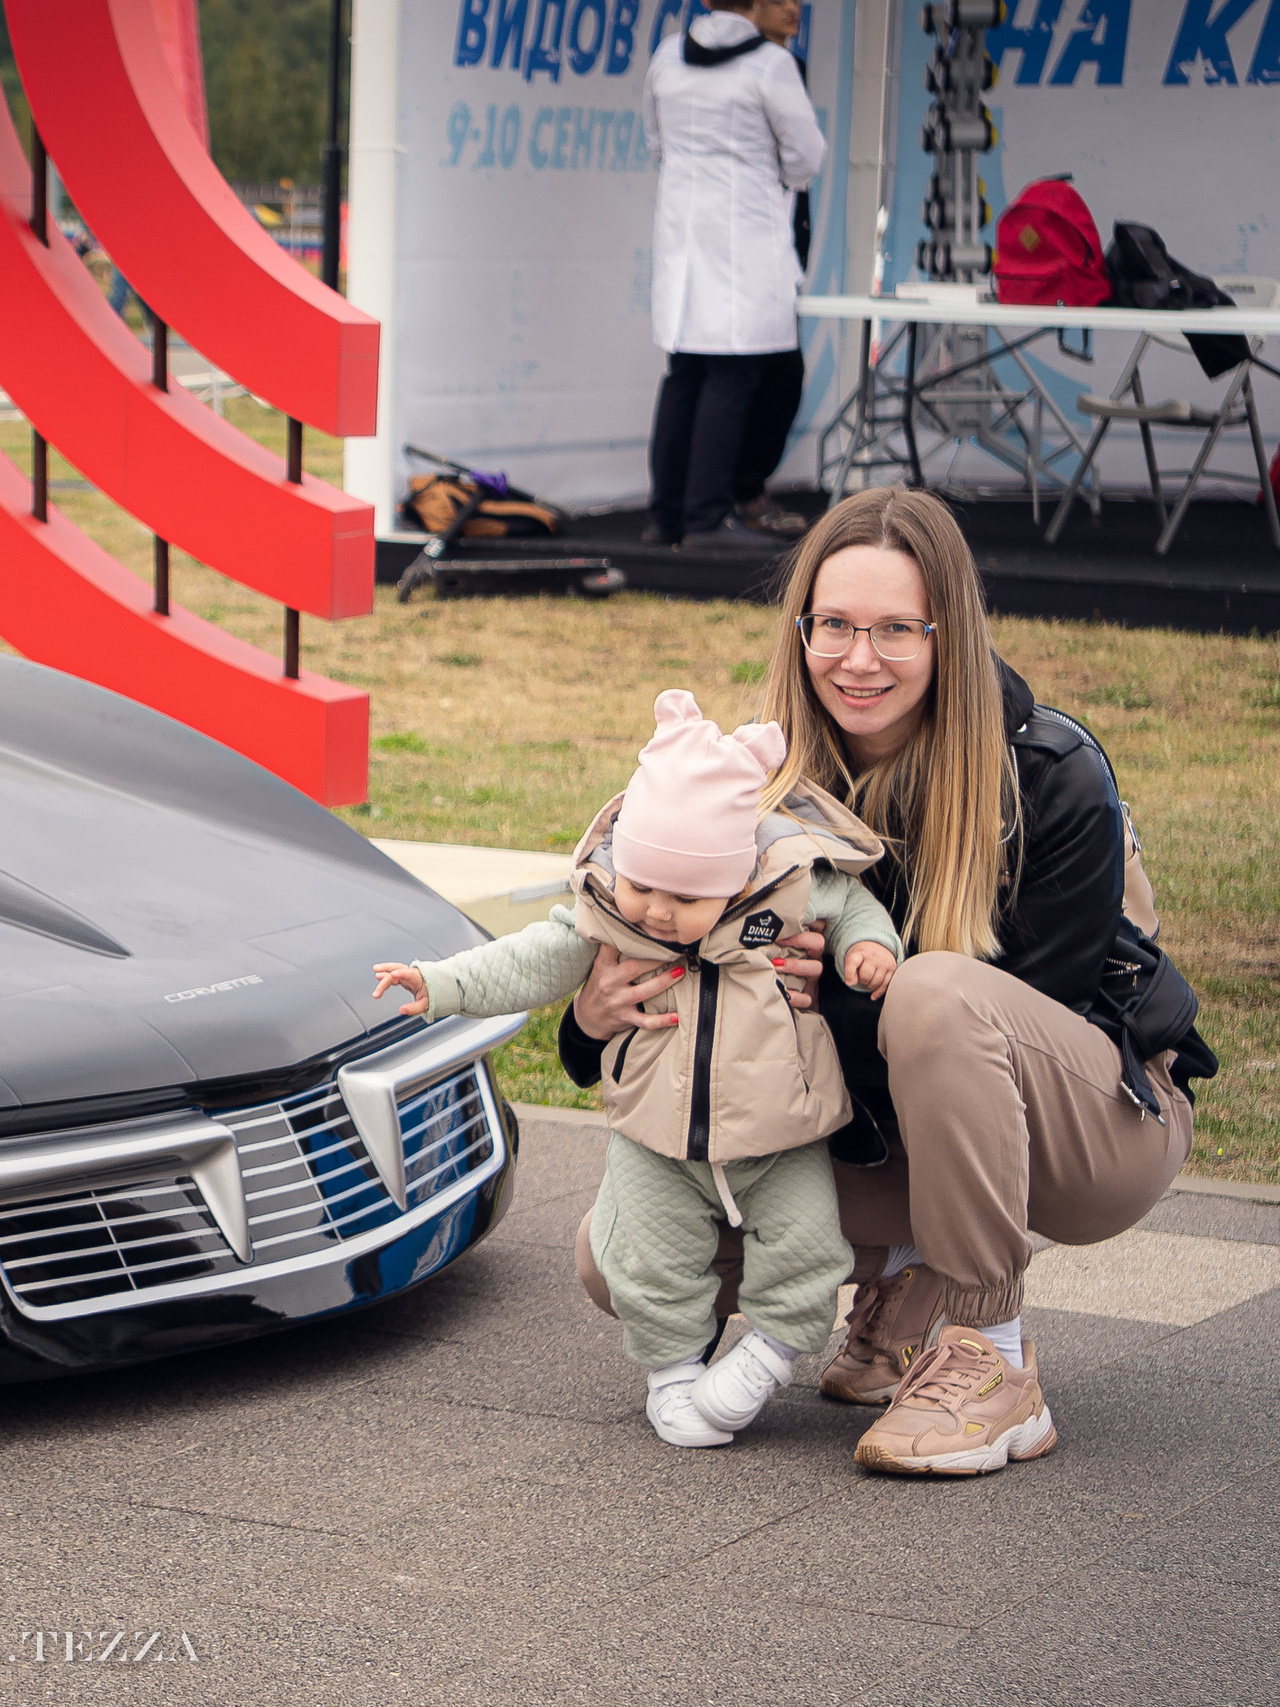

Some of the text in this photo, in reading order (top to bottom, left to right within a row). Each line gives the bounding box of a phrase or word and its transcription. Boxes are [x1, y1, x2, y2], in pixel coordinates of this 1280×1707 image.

[452, 0, 639, 84] ВИДОВ
[1162, 0, 1280, 88] К
[528, 105, 661, 173] СЕНТЯБ
[748, 925, 774, 937] DINLI
[163, 974, 263, 1003] CORVETTE
